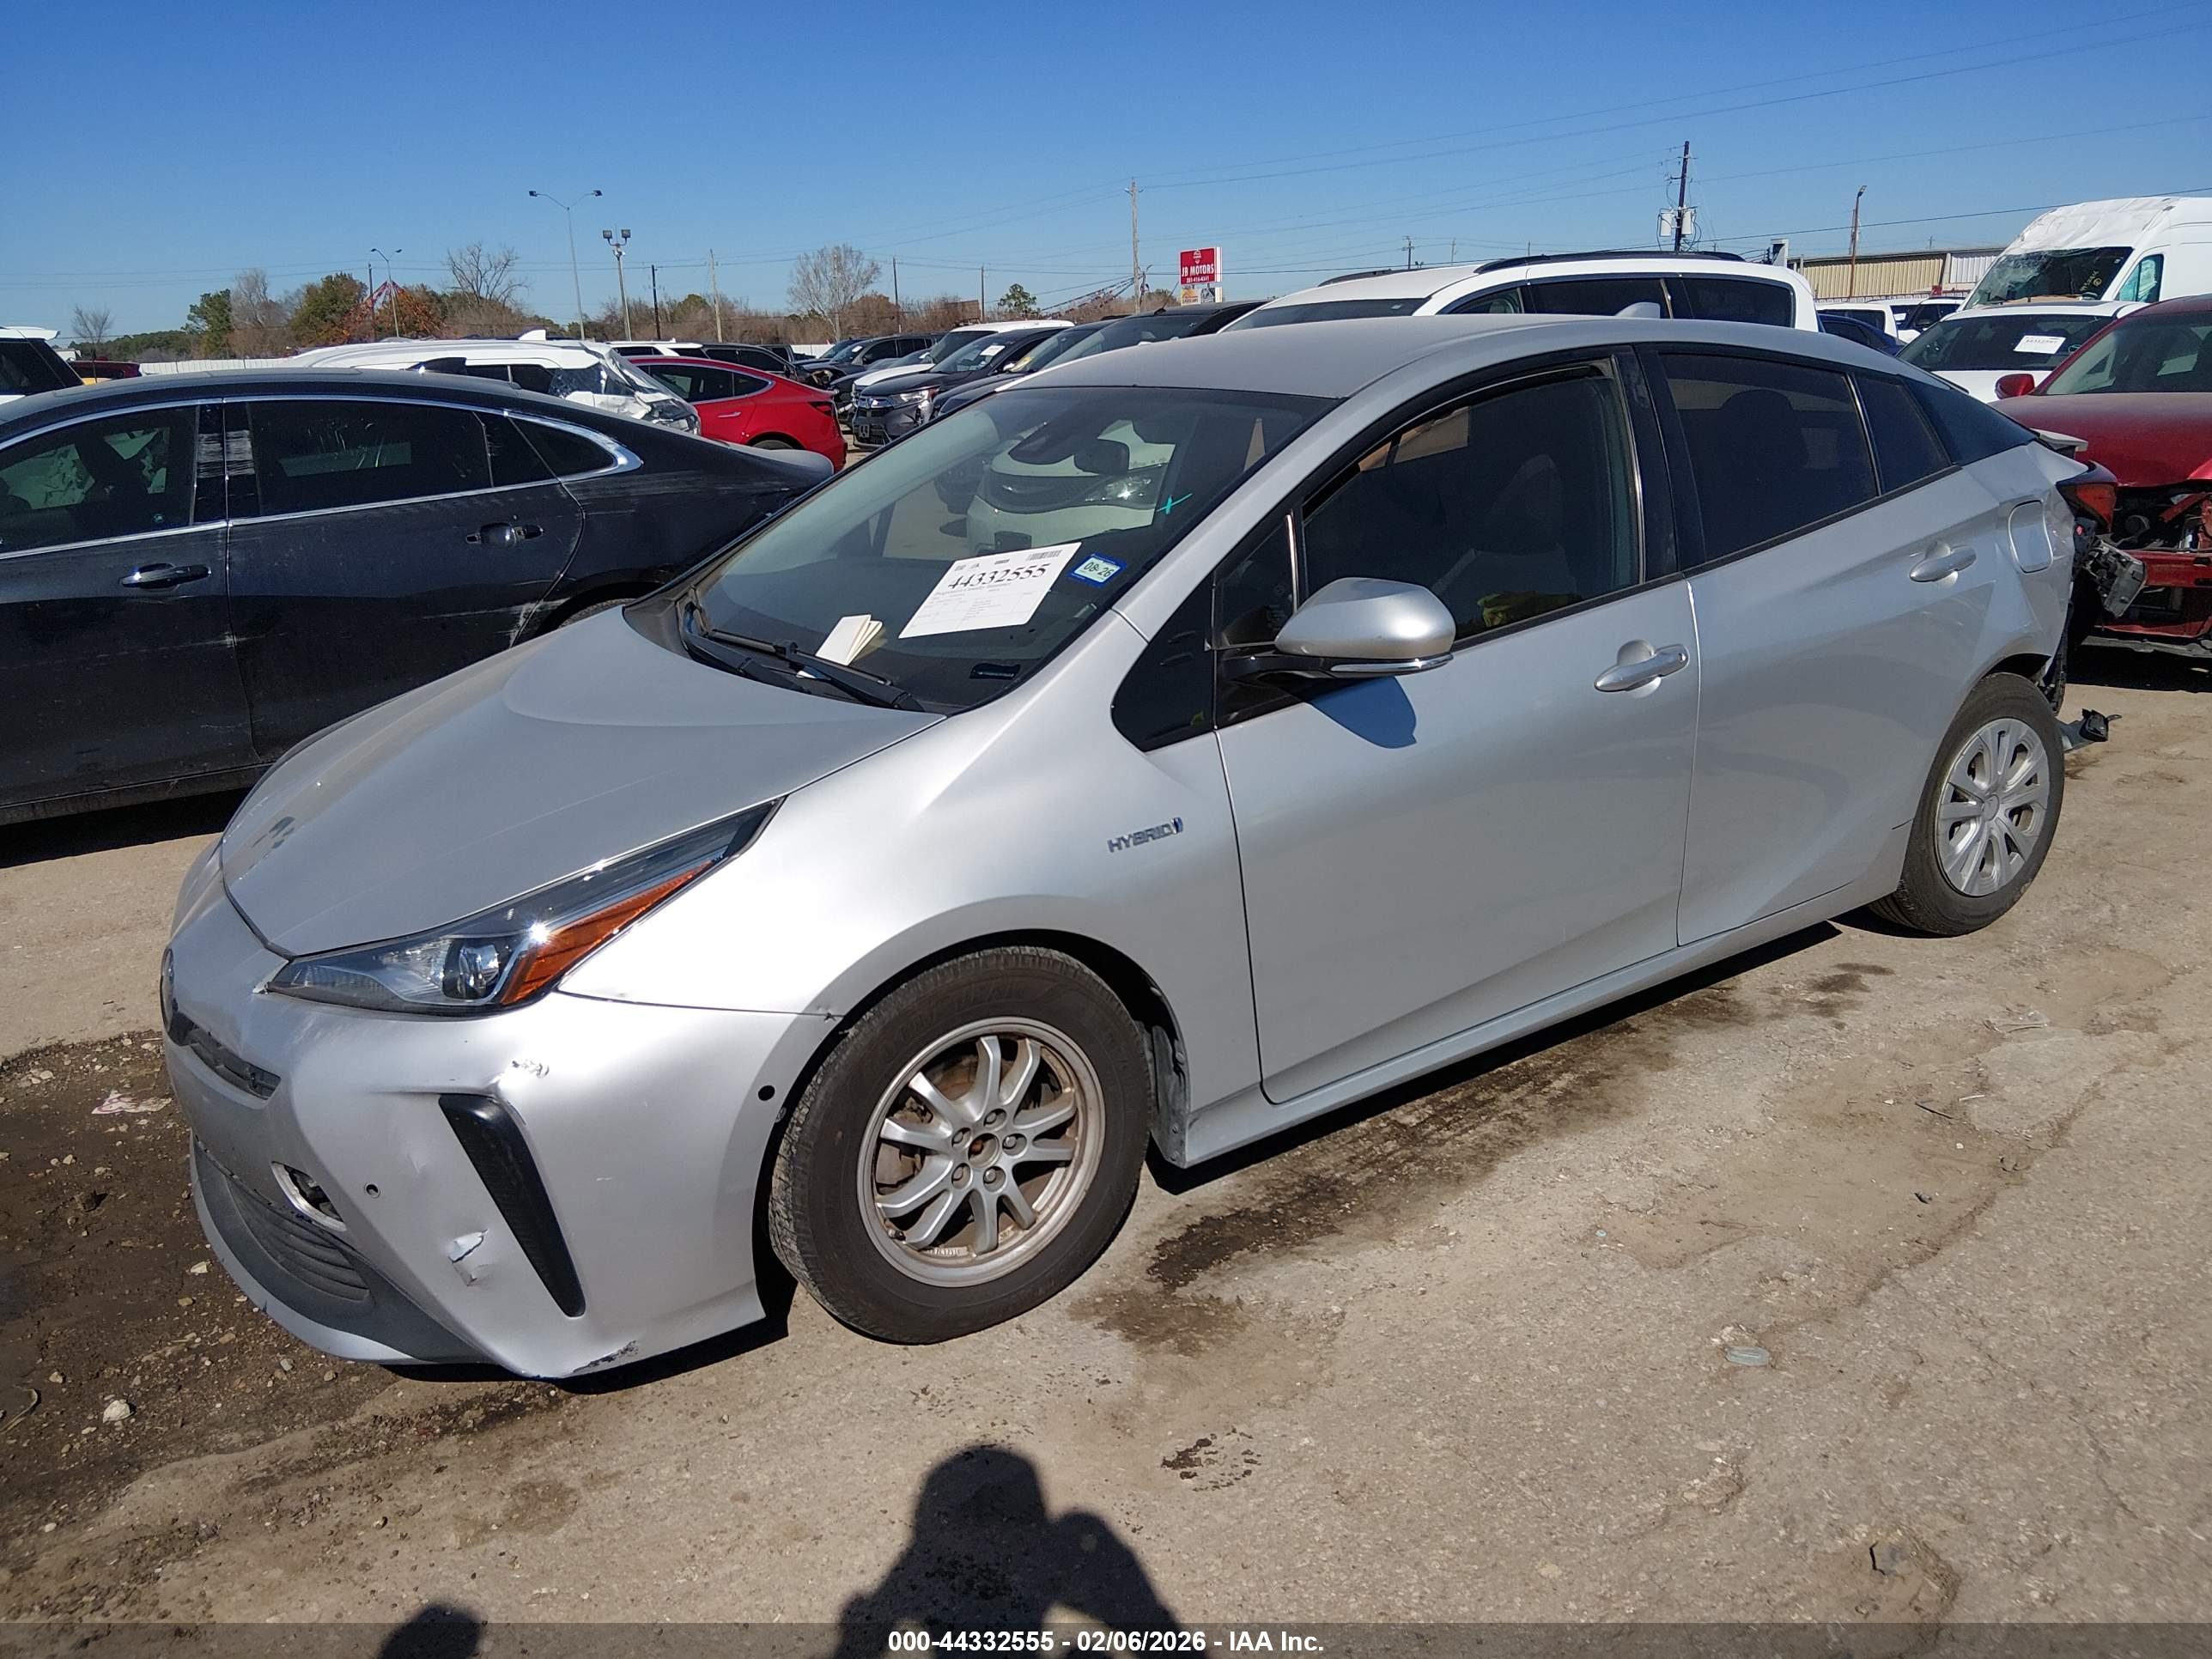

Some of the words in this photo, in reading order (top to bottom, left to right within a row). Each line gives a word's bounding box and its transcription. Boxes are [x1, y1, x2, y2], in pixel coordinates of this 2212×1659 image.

[1182, 266, 1188, 277] JB
[1189, 264, 1214, 276] MOTORS
[948, 563, 1050, 589] 44332555
[1107, 823, 1174, 853] HYBRID
